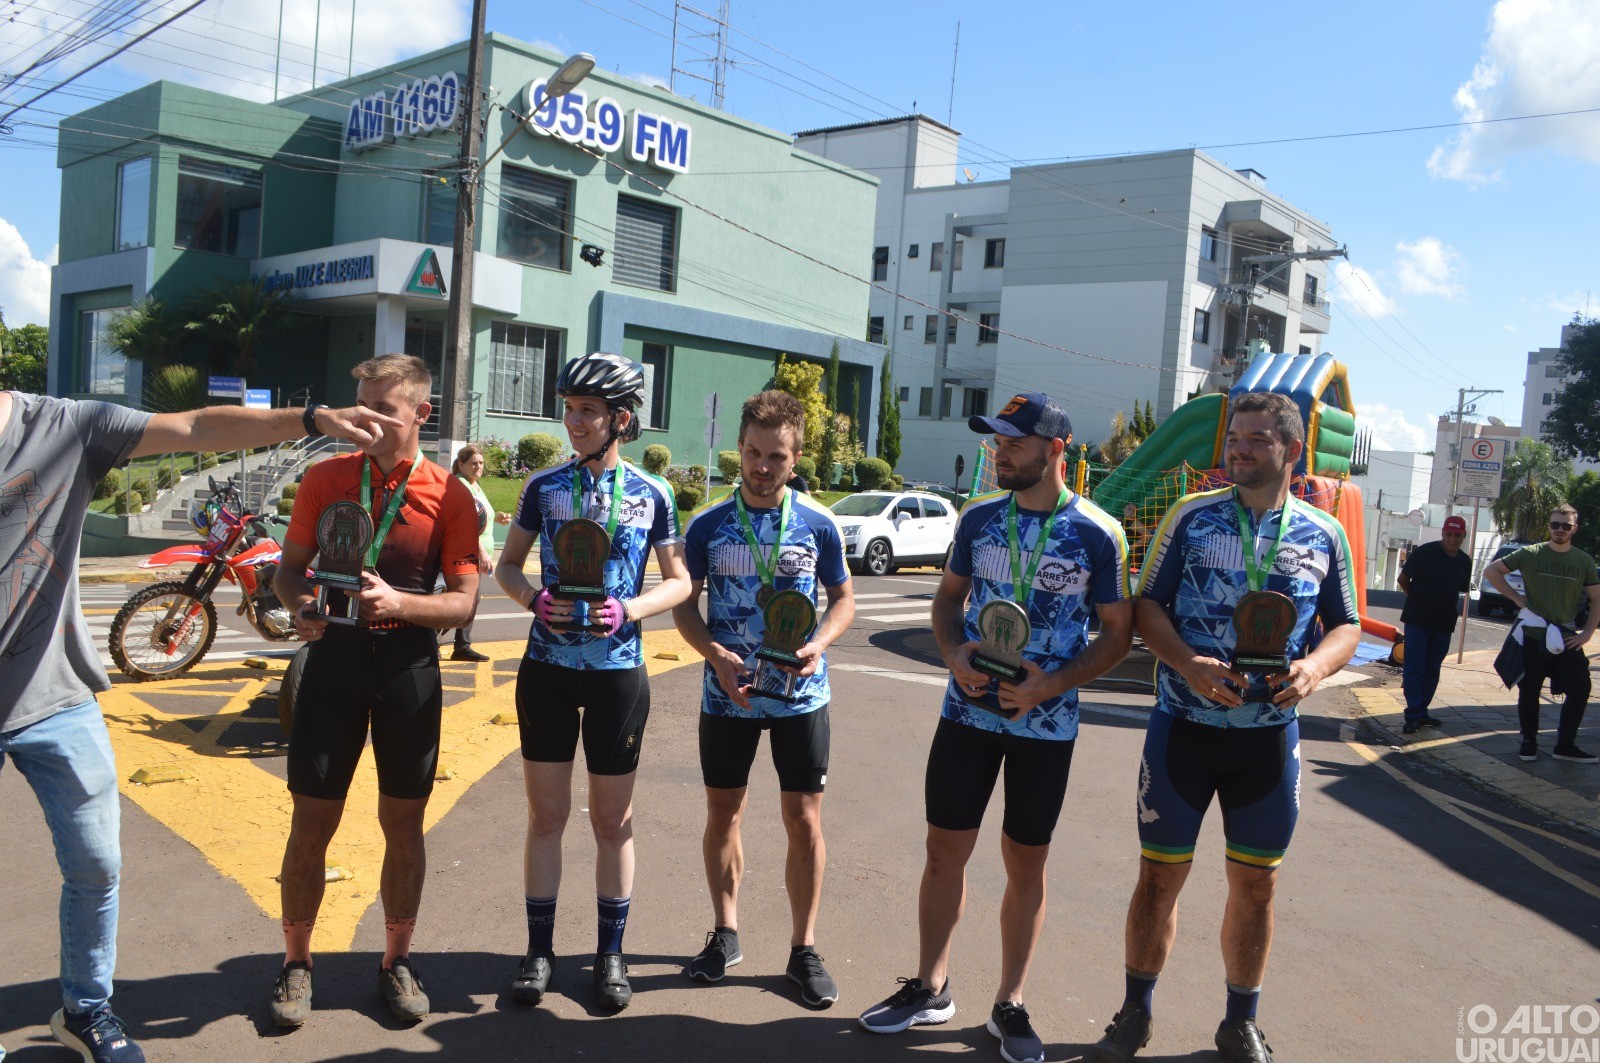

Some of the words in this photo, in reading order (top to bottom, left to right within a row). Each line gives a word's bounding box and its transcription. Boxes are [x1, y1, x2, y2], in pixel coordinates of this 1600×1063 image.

[345, 93, 385, 147] AM
[392, 74, 459, 135] 1160
[532, 81, 622, 148] 95.9
[634, 112, 689, 169] FM
[295, 263, 315, 288] LUZ
[315, 262, 325, 285] E
[324, 255, 374, 284] ALEGRIA
[1477, 444, 1488, 456] E
[1463, 461, 1481, 469] ZONA
[776, 559, 812, 568] ARRETA'S
[1035, 570, 1079, 585] ARRETA'S
